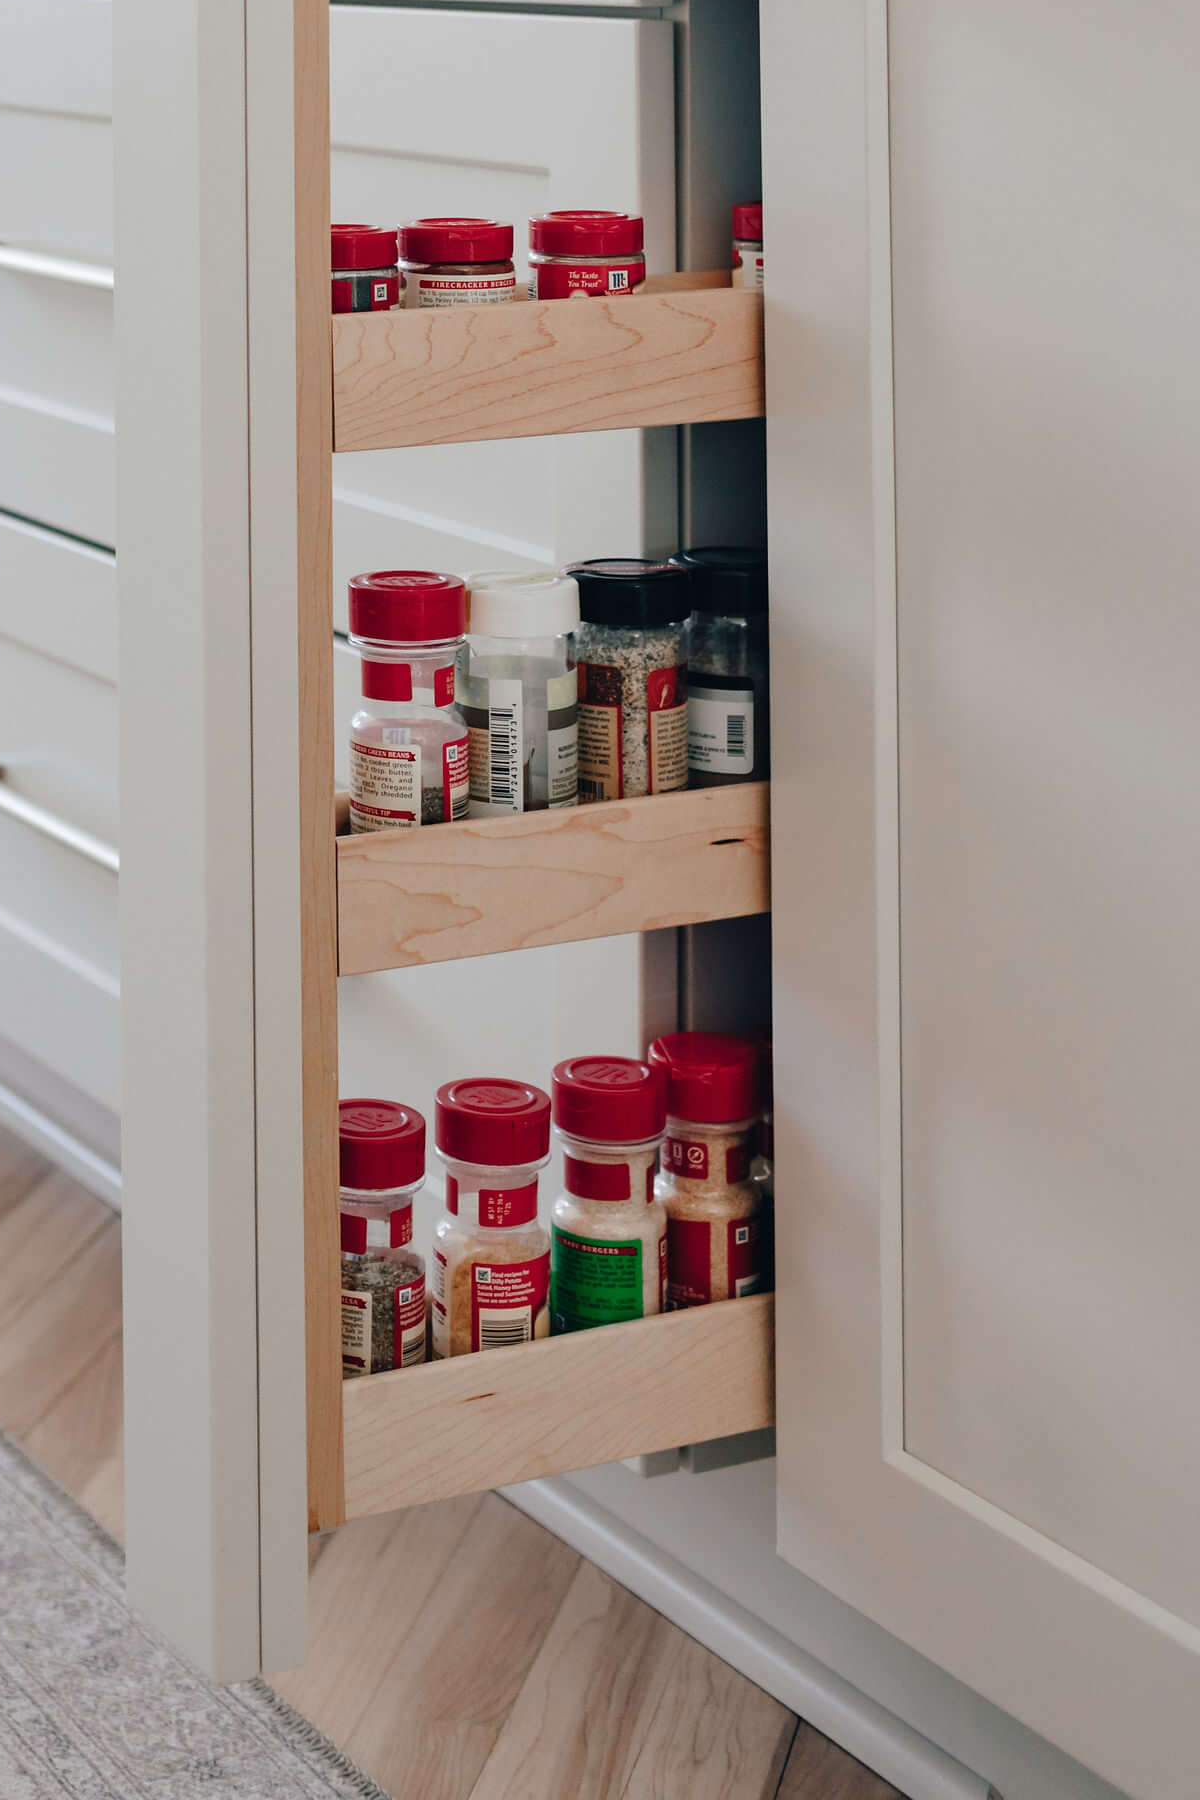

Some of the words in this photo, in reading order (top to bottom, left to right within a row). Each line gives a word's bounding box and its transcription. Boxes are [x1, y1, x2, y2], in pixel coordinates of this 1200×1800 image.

[568, 271, 580, 279] The
[581, 271, 599, 279] Taste
[431, 280, 489, 289] FIRECRACKER
[568, 280, 579, 288] You
[367, 747, 387, 757] GREEN
[387, 751, 410, 759] BEANS
[380, 782, 413, 791] Oregano
[380, 791, 413, 799] shredded
[380, 809, 391, 817] TIP
[581, 1244, 619, 1255] BURGERS
